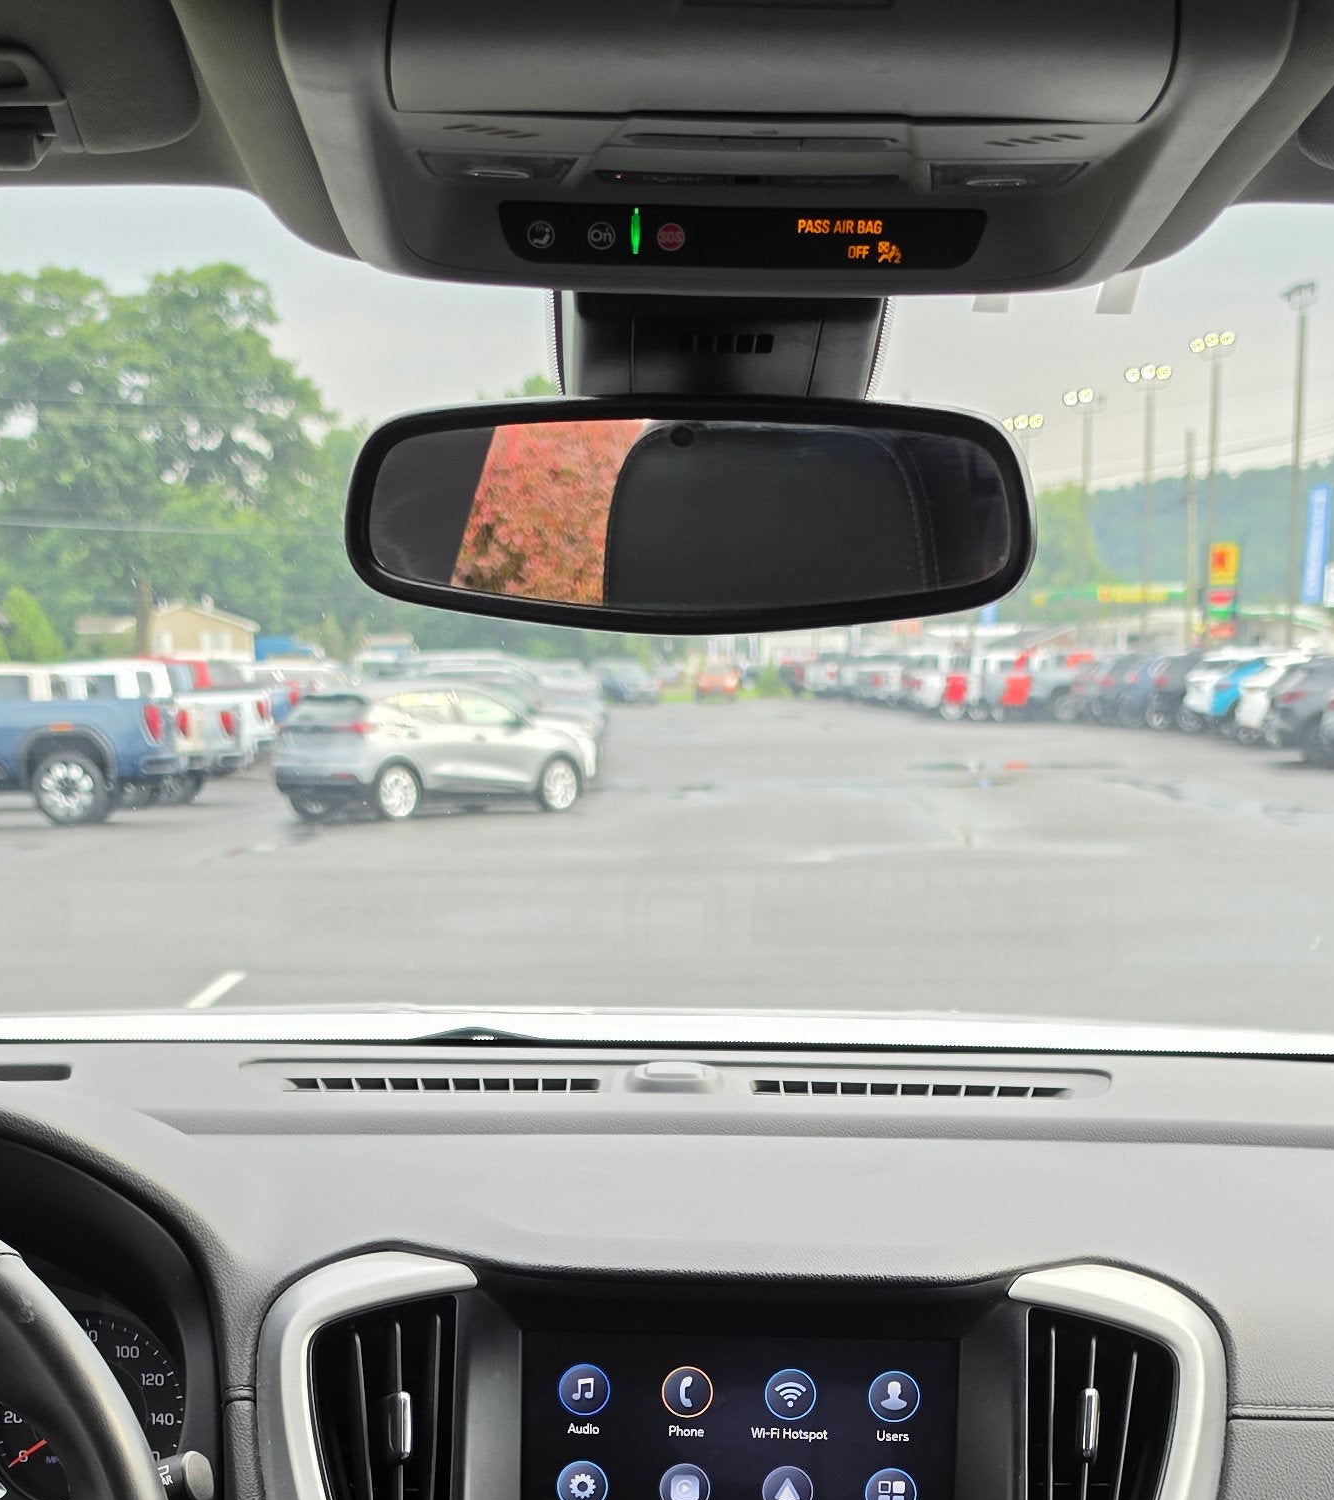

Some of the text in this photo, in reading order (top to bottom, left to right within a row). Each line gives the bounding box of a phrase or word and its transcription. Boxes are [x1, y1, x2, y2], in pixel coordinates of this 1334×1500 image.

[798, 219, 883, 235] PASS AIR BAG
[658, 229, 684, 244] SOS
[848, 245, 870, 259] OFF
[116, 1346, 140, 1359] 100
[141, 1373, 165, 1387] 120
[151, 1412, 175, 1426] 140
[567, 1422, 600, 1436] Audio
[668, 1425, 704, 1438] Phone
[750, 1427, 828, 1442] Wi-Fi Hotspot
[876, 1430, 910, 1443] Users
